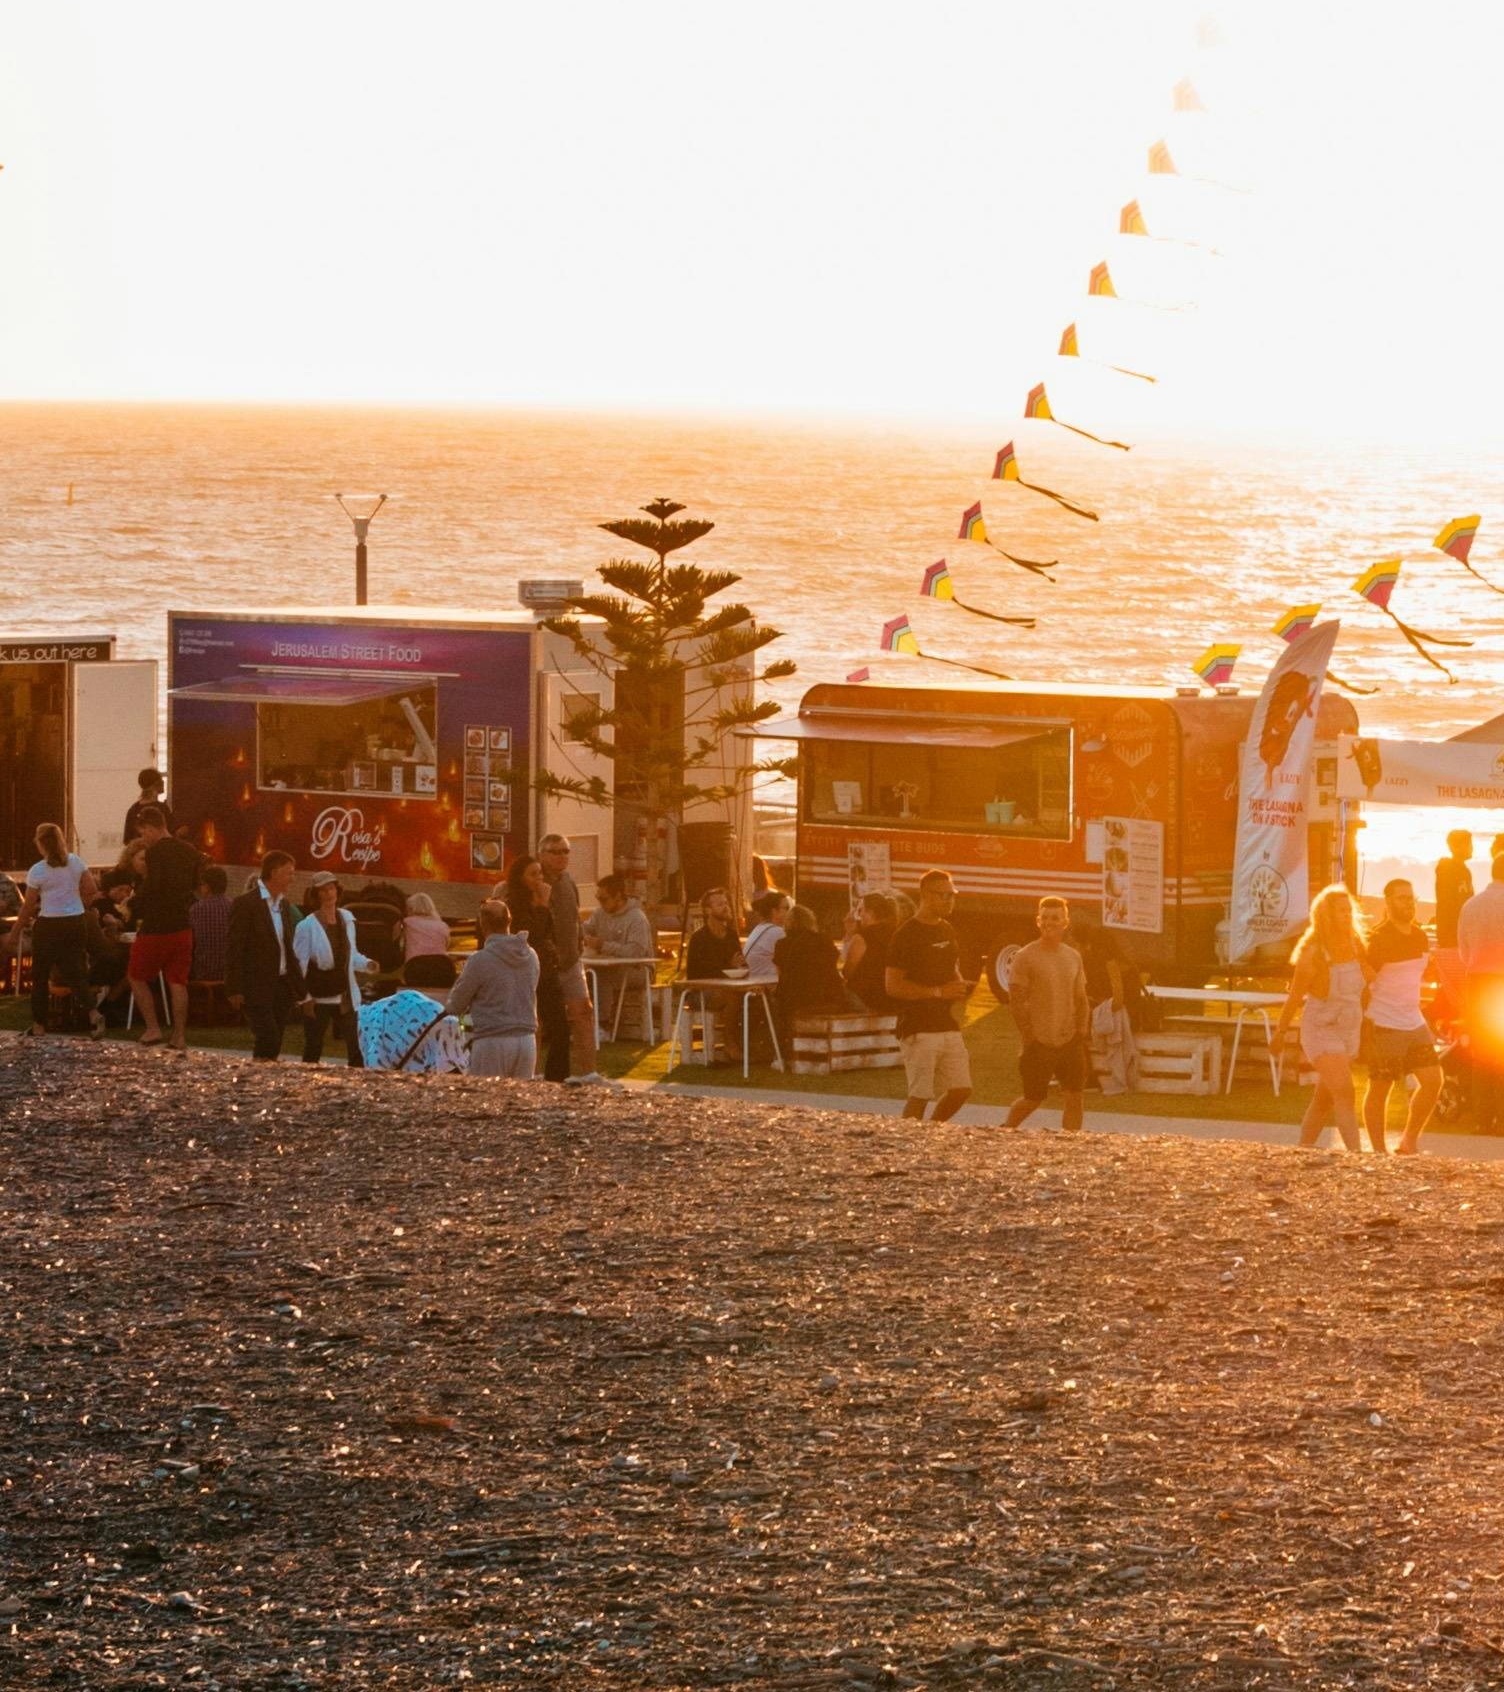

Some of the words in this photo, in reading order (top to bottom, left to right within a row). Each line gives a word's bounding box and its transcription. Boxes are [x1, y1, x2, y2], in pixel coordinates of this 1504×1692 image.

[12, 648, 30, 660] us
[33, 645, 58, 661] out
[61, 644, 97, 659] here
[271, 640, 337, 658] JERUSALEM
[341, 643, 384, 661] STREET
[388, 645, 421, 663] FOOD
[1436, 786, 1456, 798] THE
